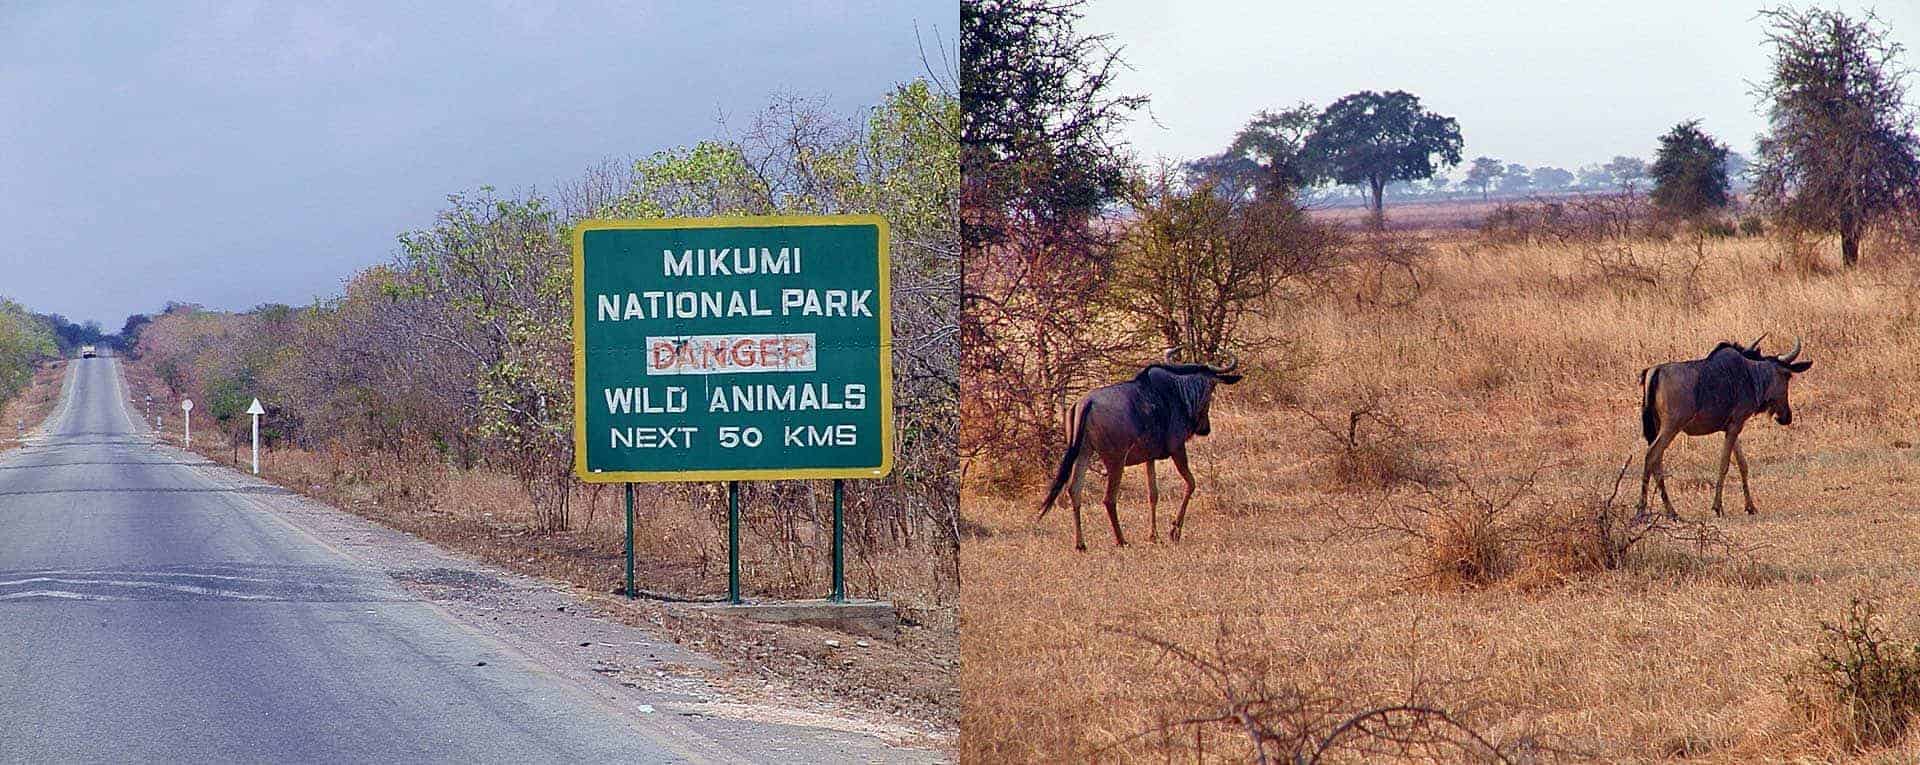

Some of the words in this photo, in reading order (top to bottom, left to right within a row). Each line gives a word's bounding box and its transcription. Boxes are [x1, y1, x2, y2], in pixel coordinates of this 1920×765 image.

[663, 247, 801, 276] MIKUMI
[597, 289, 772, 321] NATIONAL
[781, 288, 873, 317] PARK
[652, 338, 810, 370] DANGER
[604, 387, 688, 414] WILD
[709, 384, 866, 413] ANIMALS
[611, 427, 698, 449] NEXT
[719, 426, 763, 448] 50
[784, 424, 857, 448] KMS
